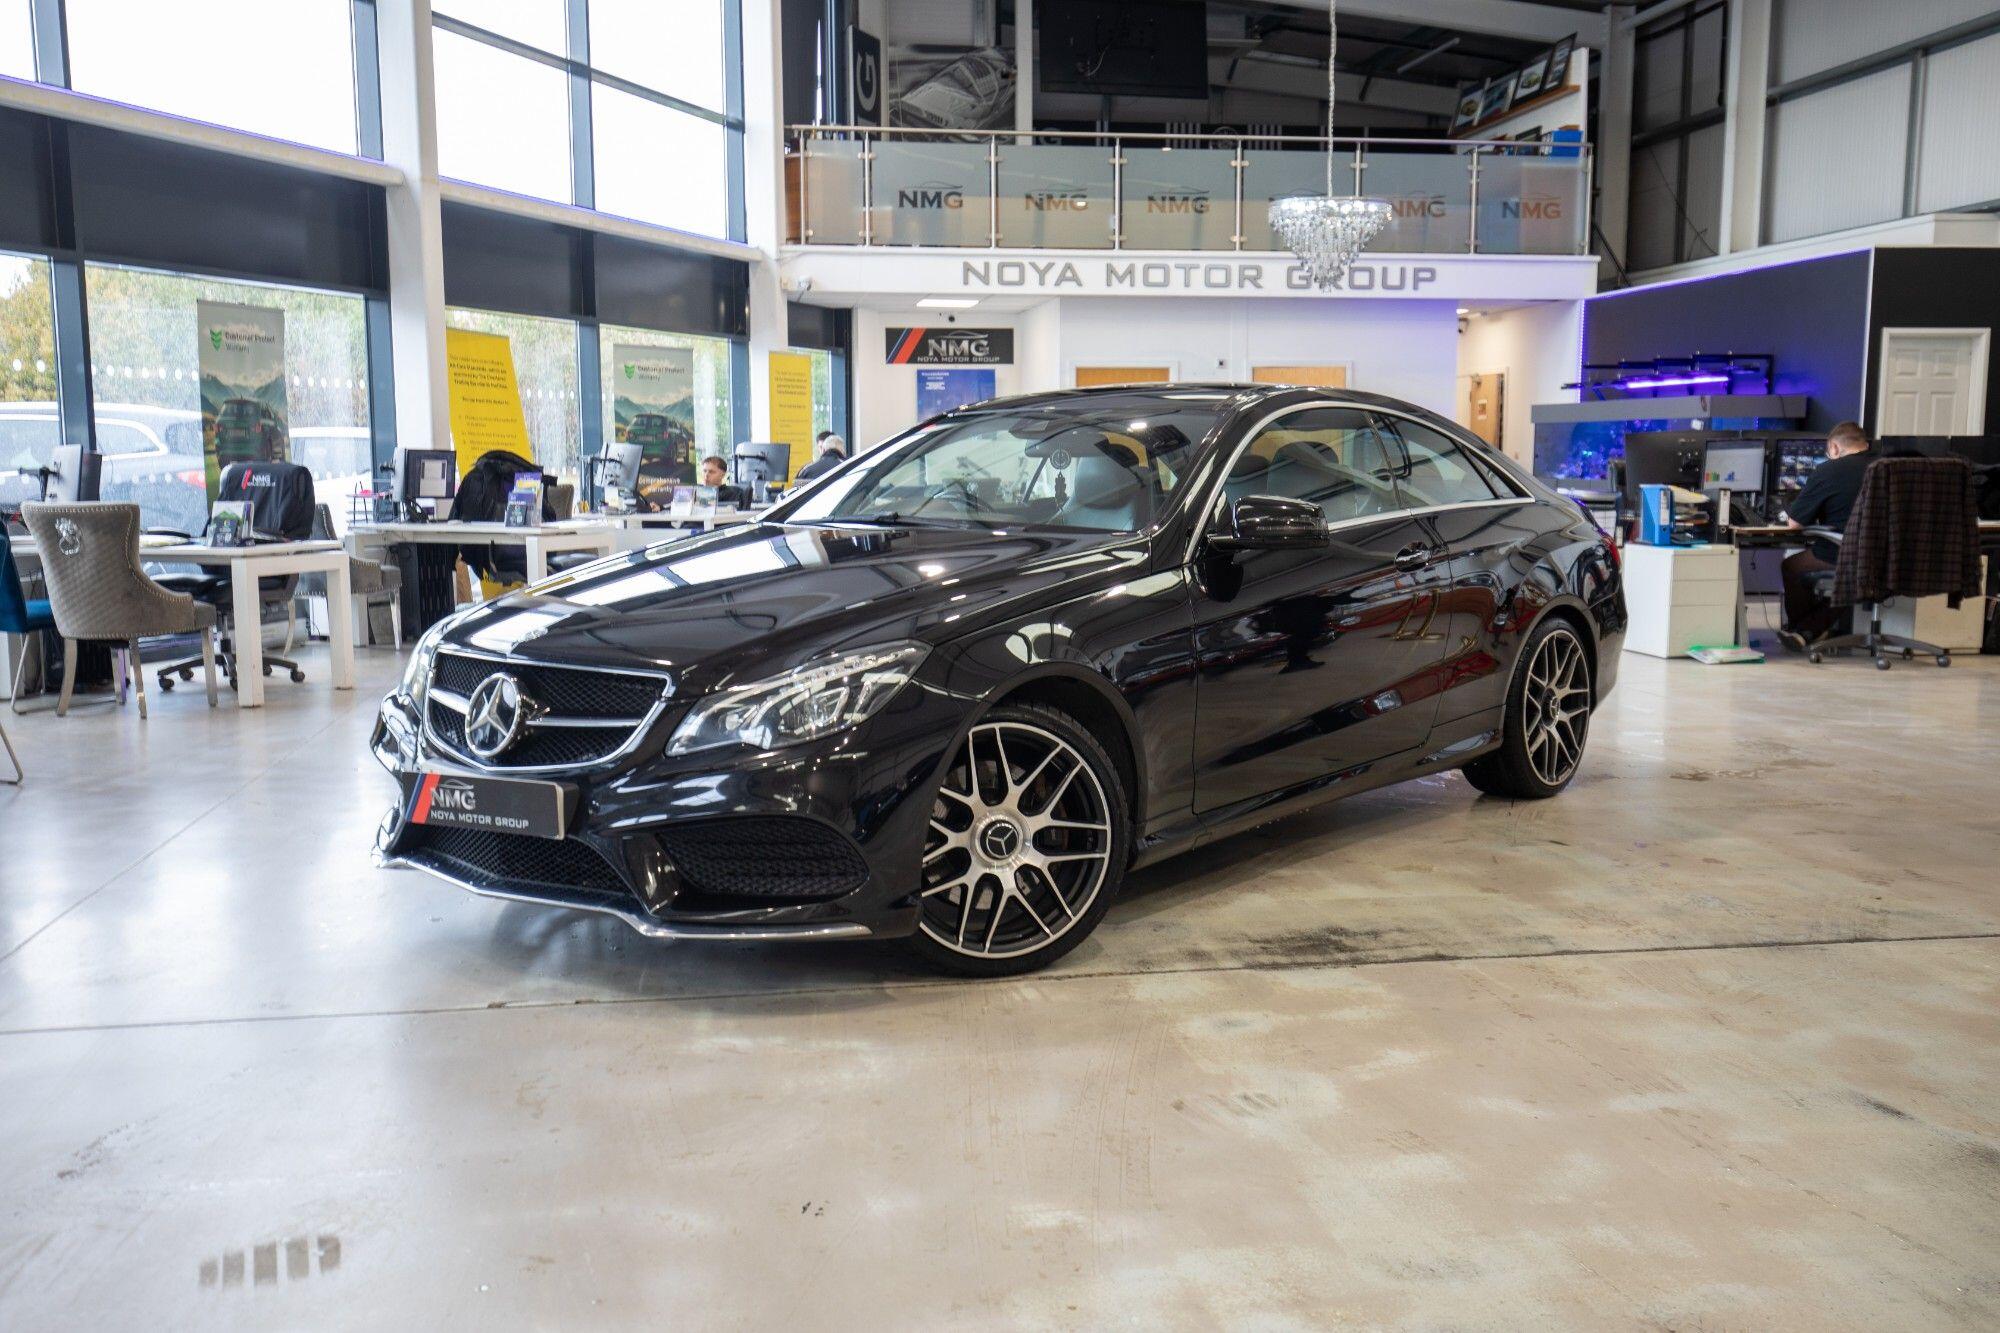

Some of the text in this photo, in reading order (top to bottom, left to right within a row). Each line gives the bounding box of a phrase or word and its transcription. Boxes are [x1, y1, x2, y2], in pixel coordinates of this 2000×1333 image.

[898, 190, 963, 209] NMG
[1025, 192, 1088, 211] NMG
[1147, 195, 1210, 213] NMG
[1502, 201, 1561, 219] NMG
[963, 261, 1083, 287] NOYA
[1106, 262, 1264, 289] MOTOR
[928, 339, 989, 356] NMG
[252, 474, 271, 484] NMG
[431, 787, 476, 811] NMG
[431, 809, 529, 829] NOYA MOTOR GROUP
